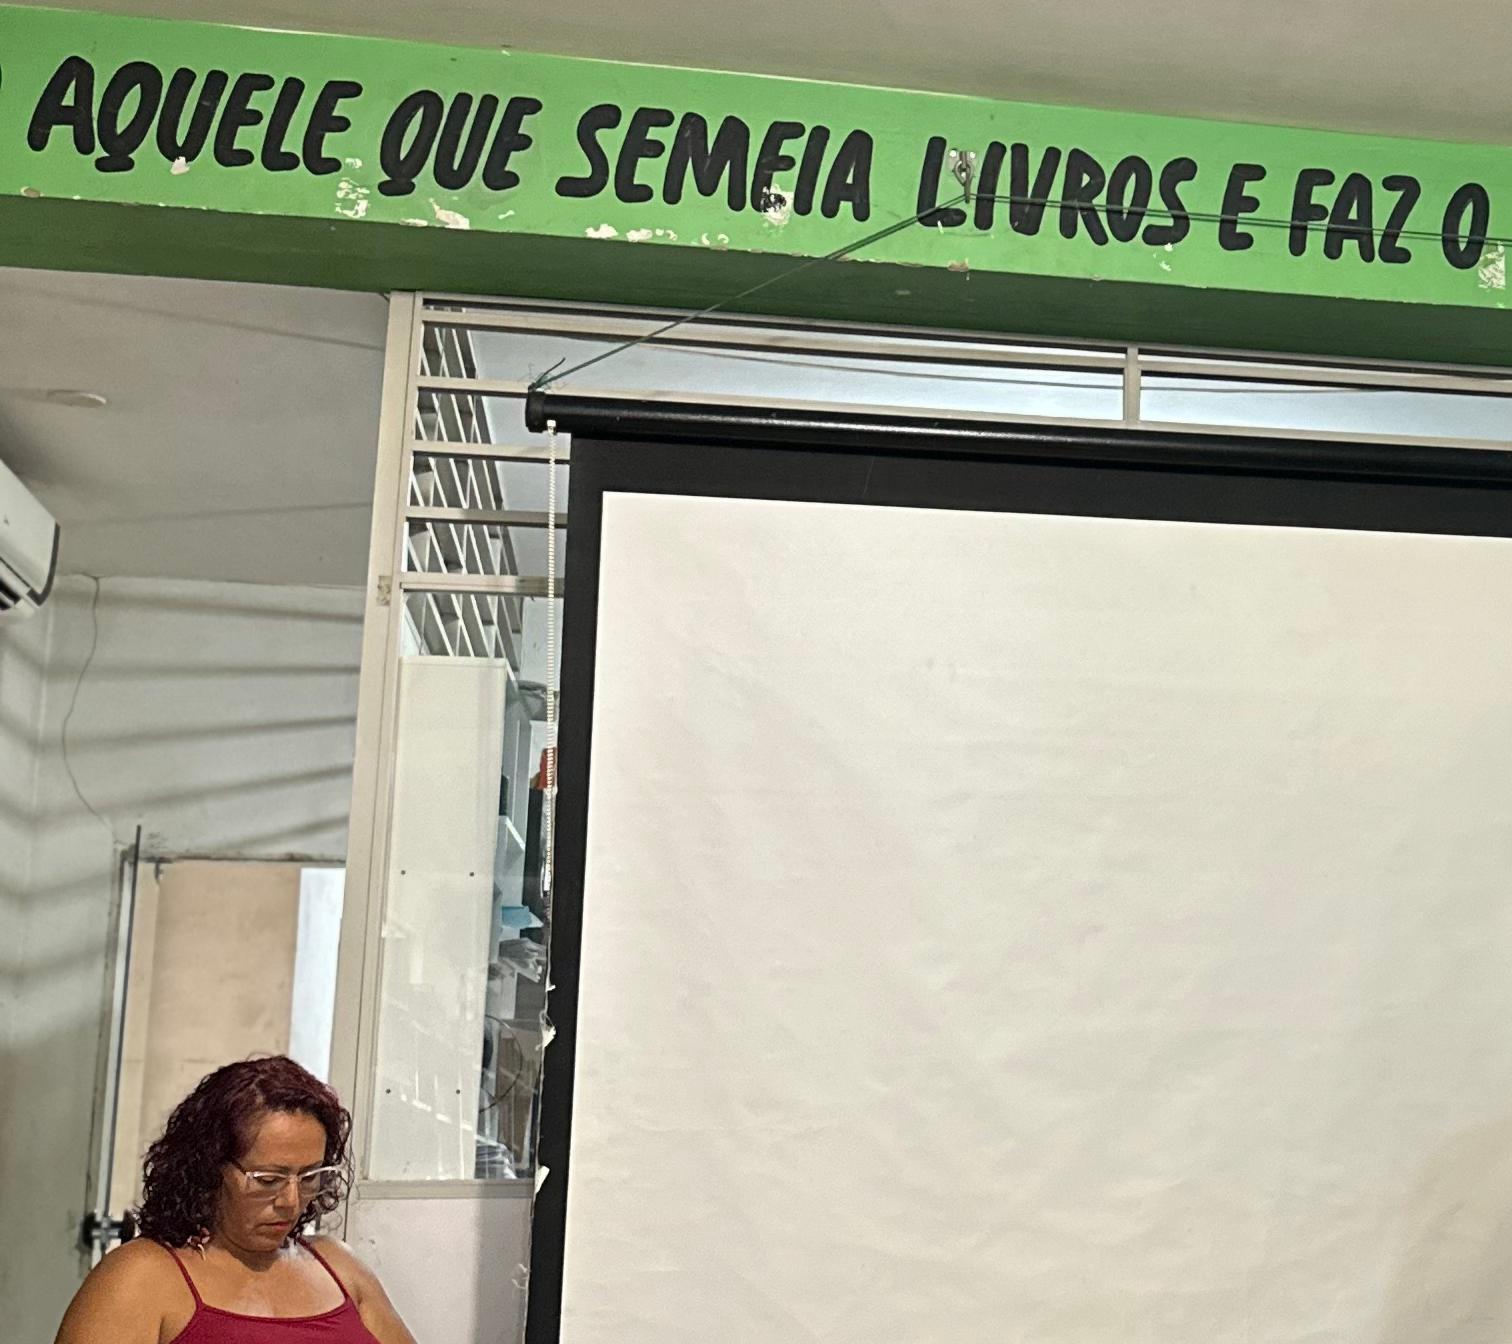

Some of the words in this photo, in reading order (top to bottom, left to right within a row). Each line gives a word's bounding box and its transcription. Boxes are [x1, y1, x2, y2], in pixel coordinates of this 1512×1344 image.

[28, 56, 363, 175] AQUELE
[378, 89, 543, 197] QUE
[556, 103, 874, 222] SEMEIA
[916, 136, 1198, 247] LIVROS
[1218, 163, 1267, 252] E
[1288, 168, 1422, 265] FAZ
[1441, 182, 1490, 270] O
